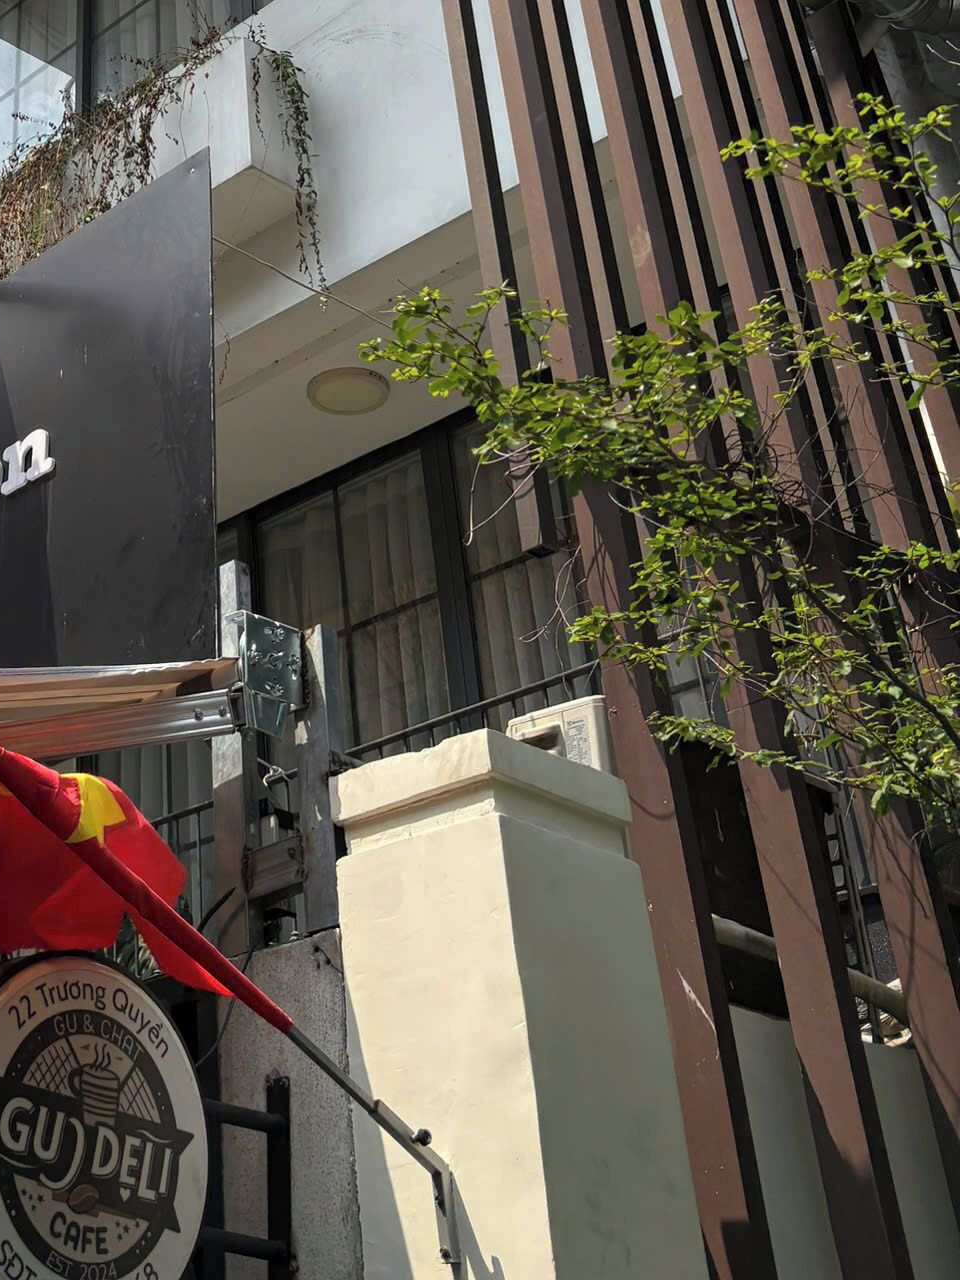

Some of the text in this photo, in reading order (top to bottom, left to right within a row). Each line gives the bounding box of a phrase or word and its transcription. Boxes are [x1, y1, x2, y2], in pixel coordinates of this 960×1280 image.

[8, 980, 169, 1058] 22 Trương Quyền
[54, 1014, 144, 1061] GU & CHAT
[49, 1211, 109, 1255] CAFE
[46, 1250, 74, 1278] EST
